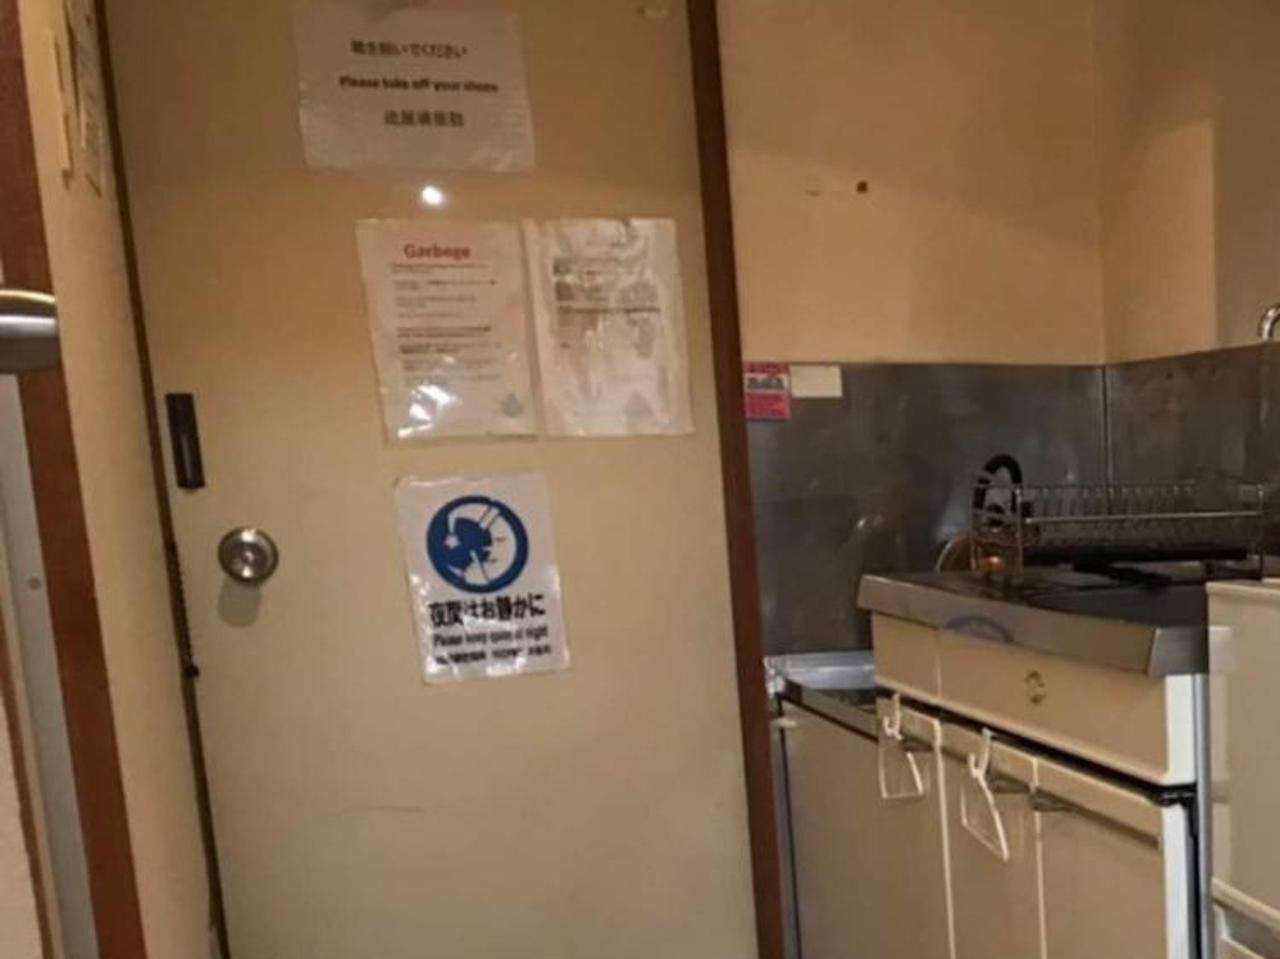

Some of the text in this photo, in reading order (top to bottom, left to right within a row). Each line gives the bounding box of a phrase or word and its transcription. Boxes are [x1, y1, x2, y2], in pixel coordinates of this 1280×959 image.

[339, 75, 380, 88] Please
[412, 77, 430, 90] off
[433, 80, 461, 92] your
[433, 634, 462, 648] Please
